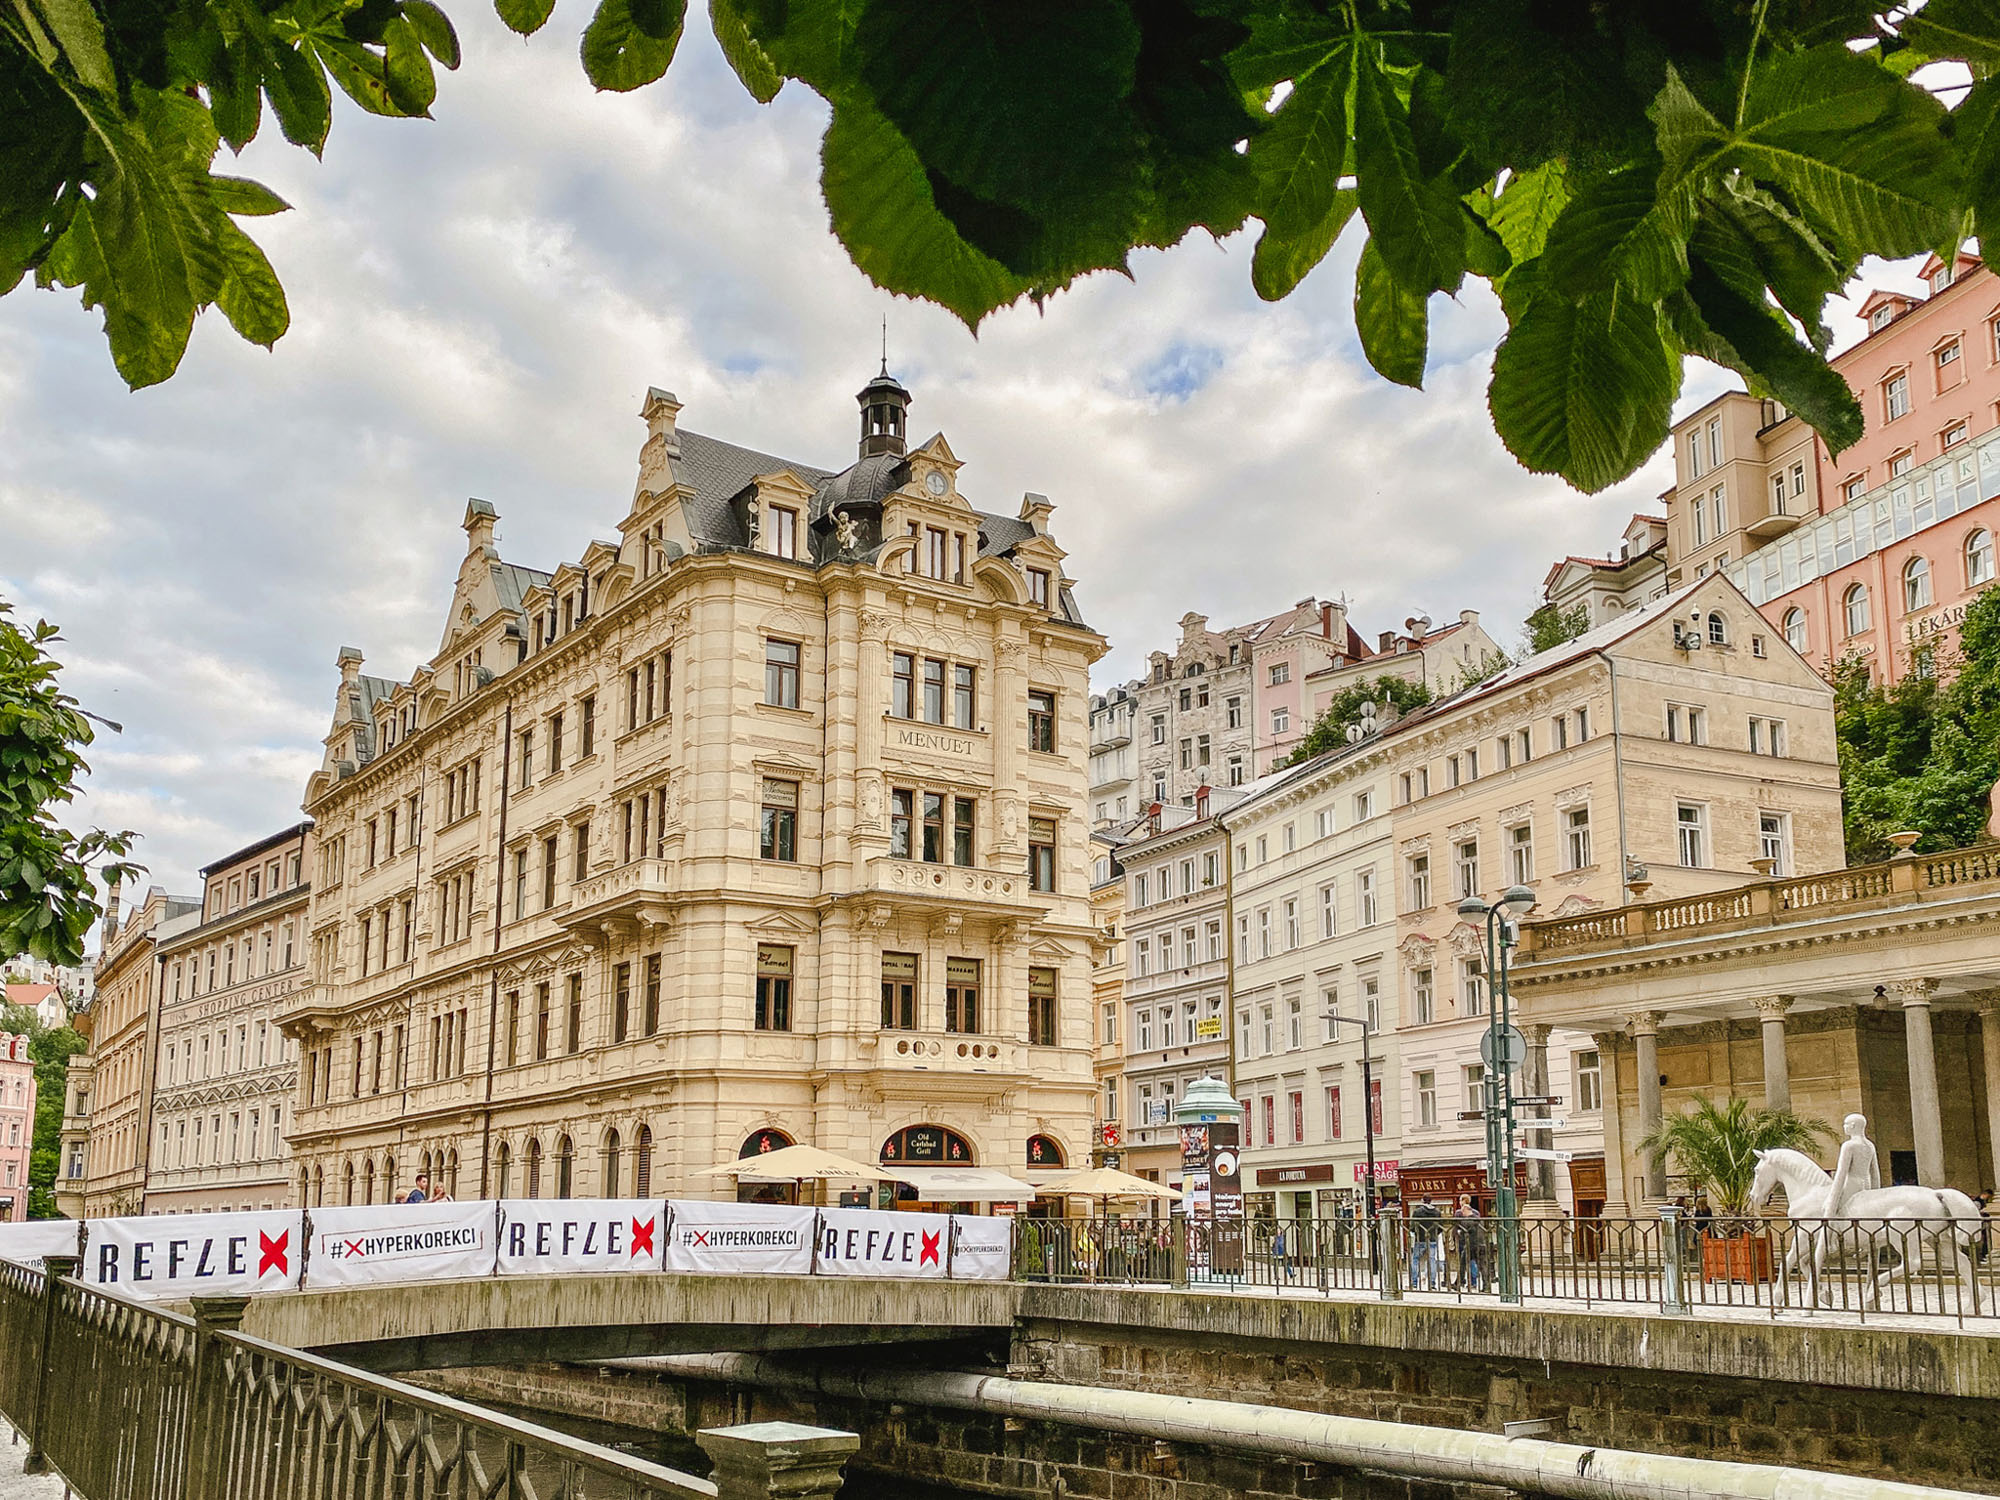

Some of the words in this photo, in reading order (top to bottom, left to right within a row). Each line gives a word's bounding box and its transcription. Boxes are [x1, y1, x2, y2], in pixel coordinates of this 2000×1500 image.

[898, 729, 975, 755] MENUET
[198, 992, 246, 1018] SHOPPING
[251, 979, 294, 1002] CENTER
[1357, 1169, 1399, 1181] MSAGE
[1411, 1178, 1446, 1191] DÁRKY
[99, 1228, 288, 1283] REFLEX
[509, 1215, 655, 1259] REFLEX
[824, 1227, 940, 1268] REFLEX
